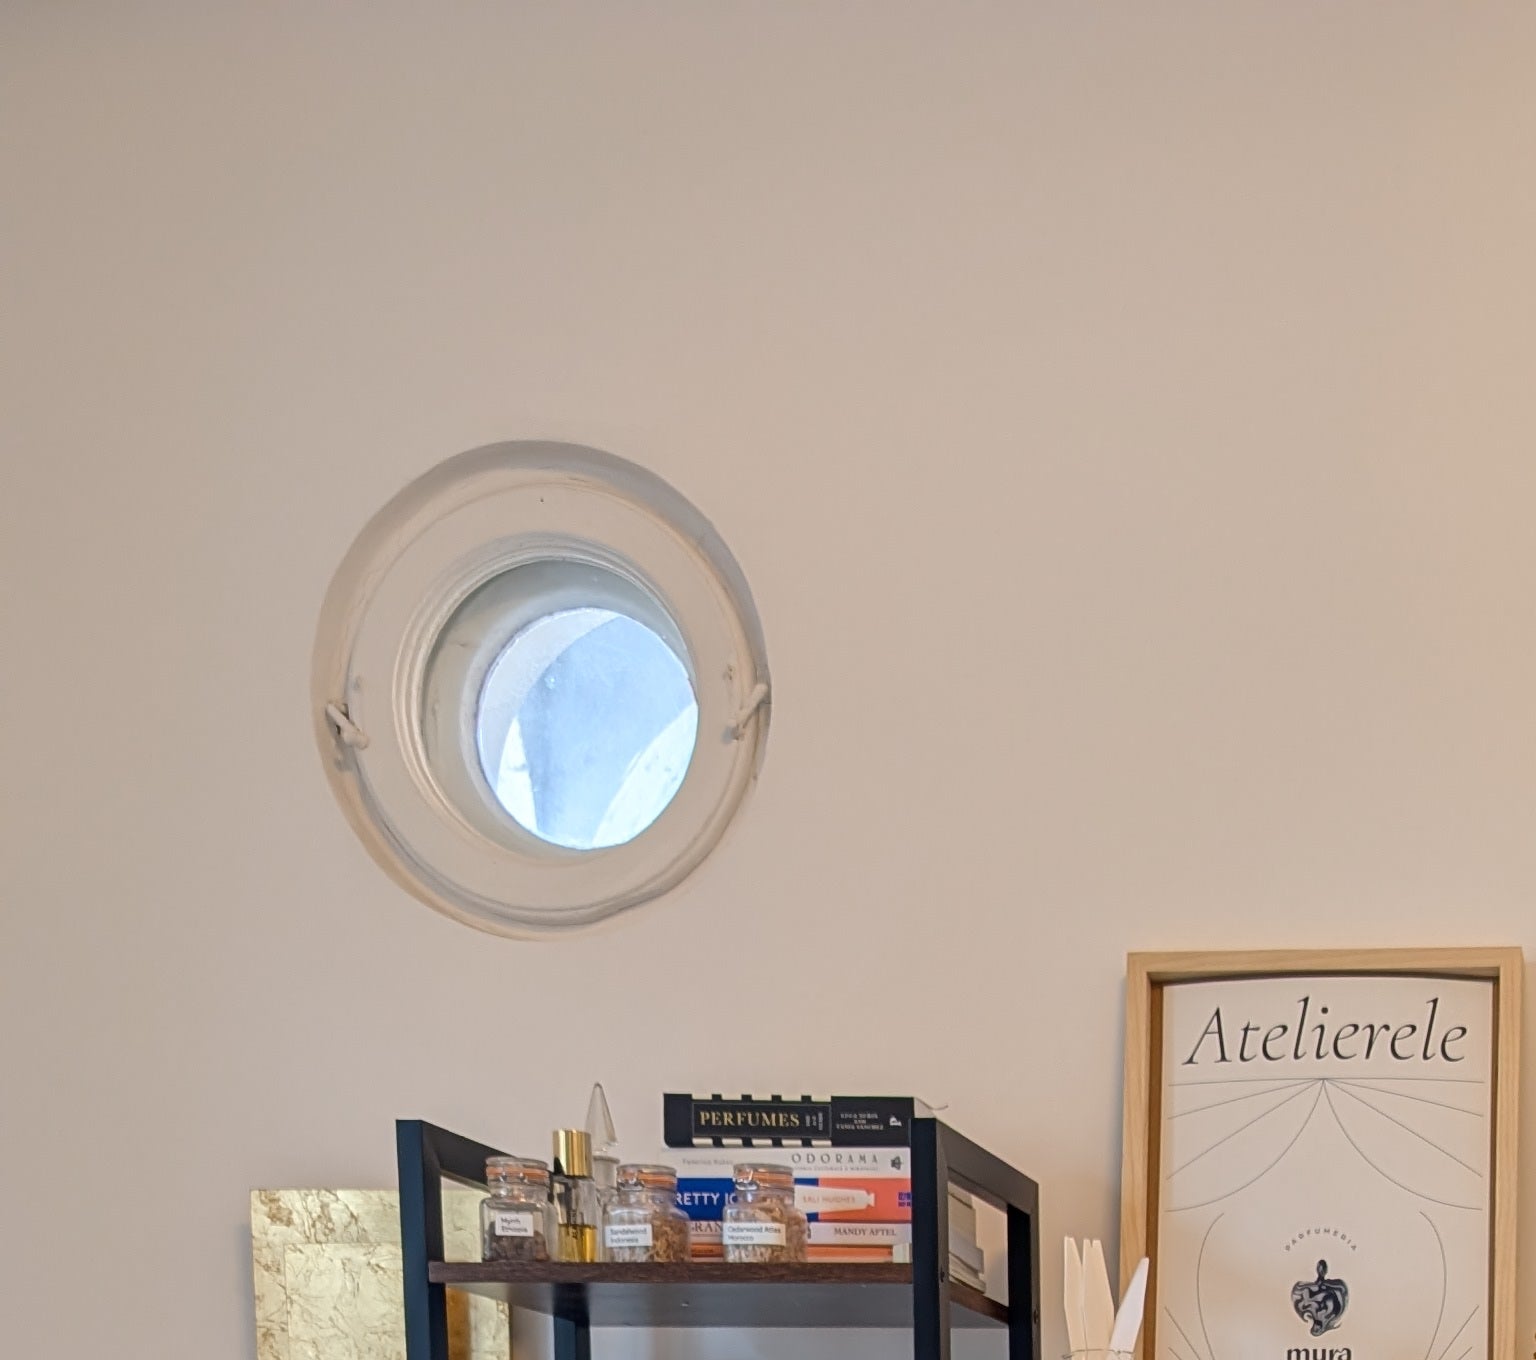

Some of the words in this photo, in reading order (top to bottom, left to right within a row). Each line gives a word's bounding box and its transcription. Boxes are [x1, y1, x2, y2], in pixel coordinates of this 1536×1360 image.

[1181, 996, 1468, 1066] Atelierele
[700, 1111, 800, 1127] PERFUMES
[791, 1154, 879, 1164] ODORAMA
[676, 1192, 722, 1206] RETTY
[834, 1227, 866, 1236] MANDY
[869, 1227, 897, 1236] AFTEL
